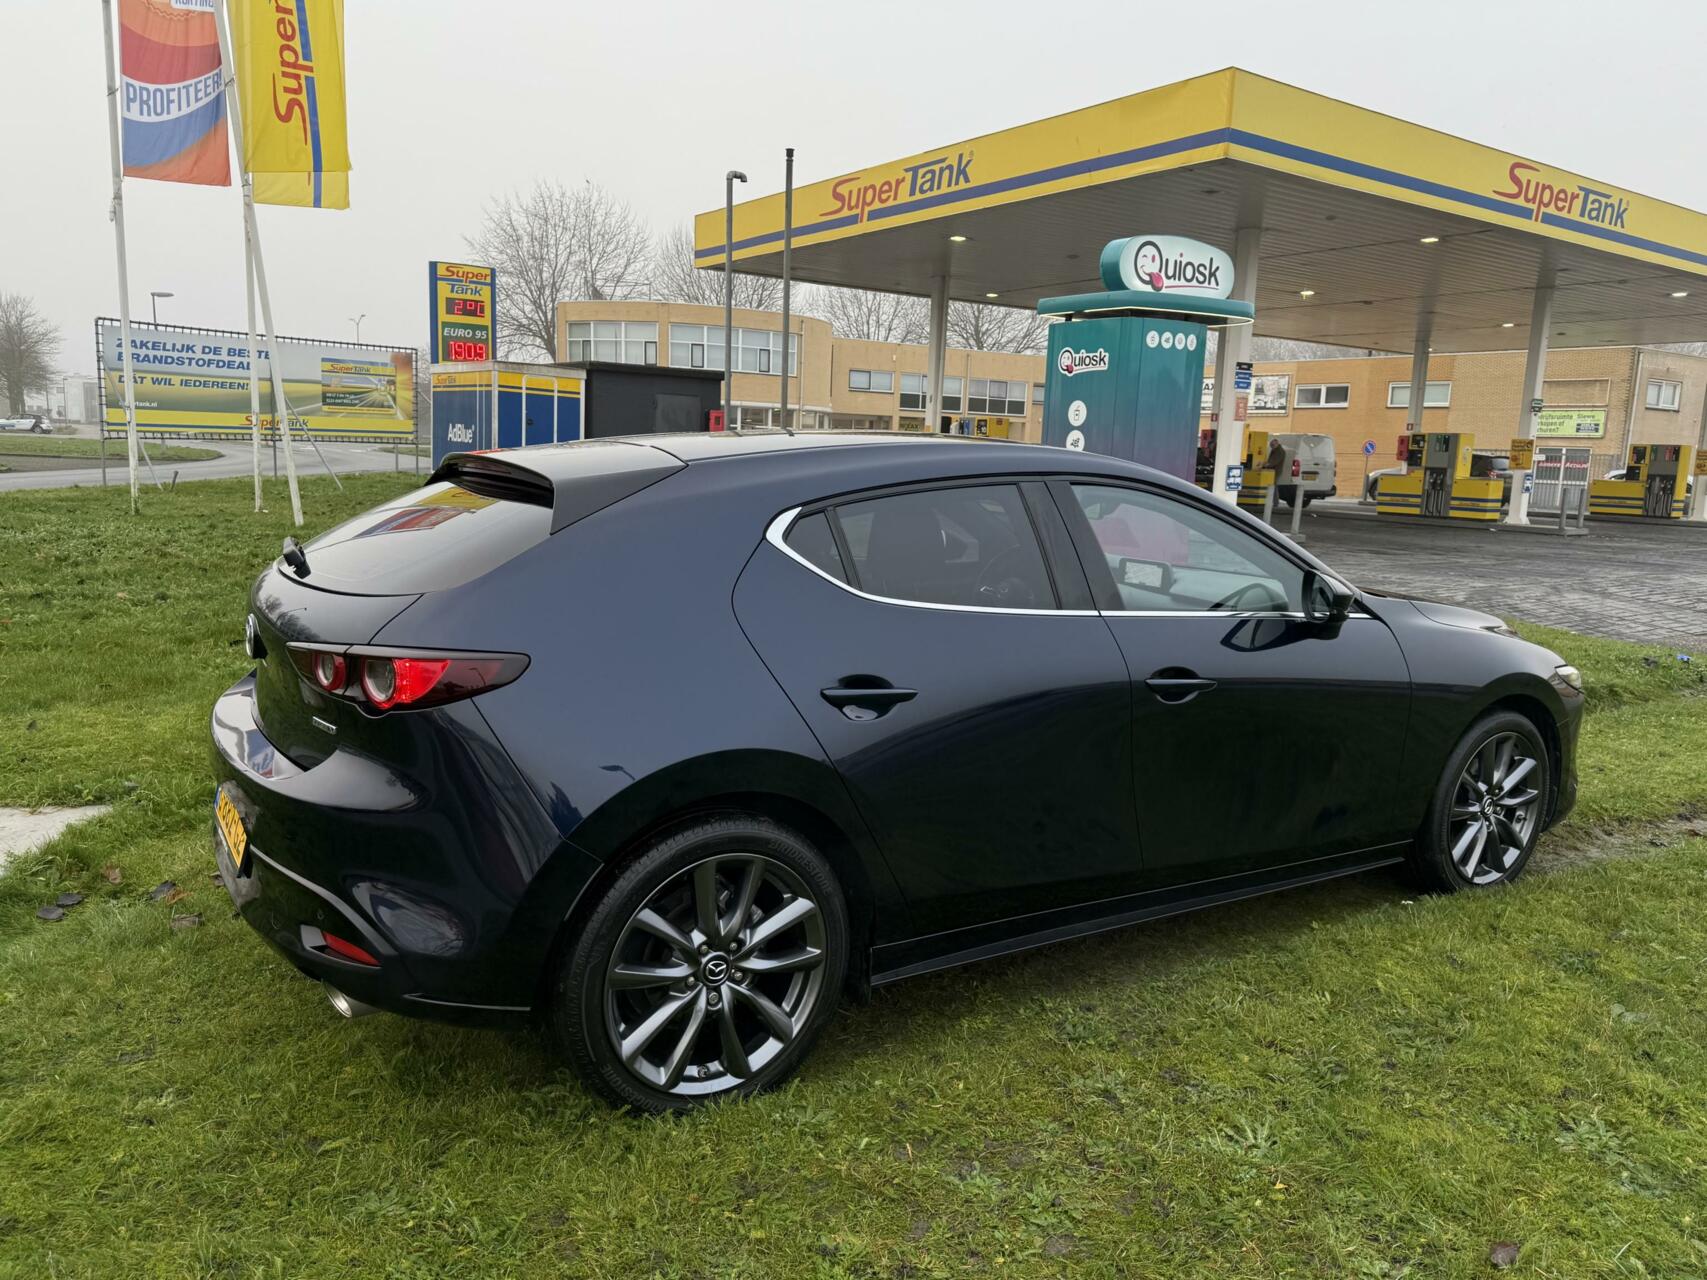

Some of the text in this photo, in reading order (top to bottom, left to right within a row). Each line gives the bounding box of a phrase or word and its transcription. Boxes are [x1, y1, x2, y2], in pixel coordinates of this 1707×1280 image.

[272, 0, 314, 146] Super
[125, 68, 223, 117] PROFITEER!
[819, 153, 973, 223] SuperTank
[1492, 162, 1630, 229] SuperTank
[437, 265, 490, 284] Super
[1134, 240, 1220, 291] Quiosk
[447, 283, 482, 297] Tank
[443, 327, 487, 339] EURO 95
[201, 346, 223, 356] DE
[449, 341, 487, 361] 190.9
[1059, 349, 1107, 374] Quiosk
[151, 376, 175, 386] WIL
[180, 378, 249, 390] IEDEREEN!
[448, 423, 473, 443] AdBlue
